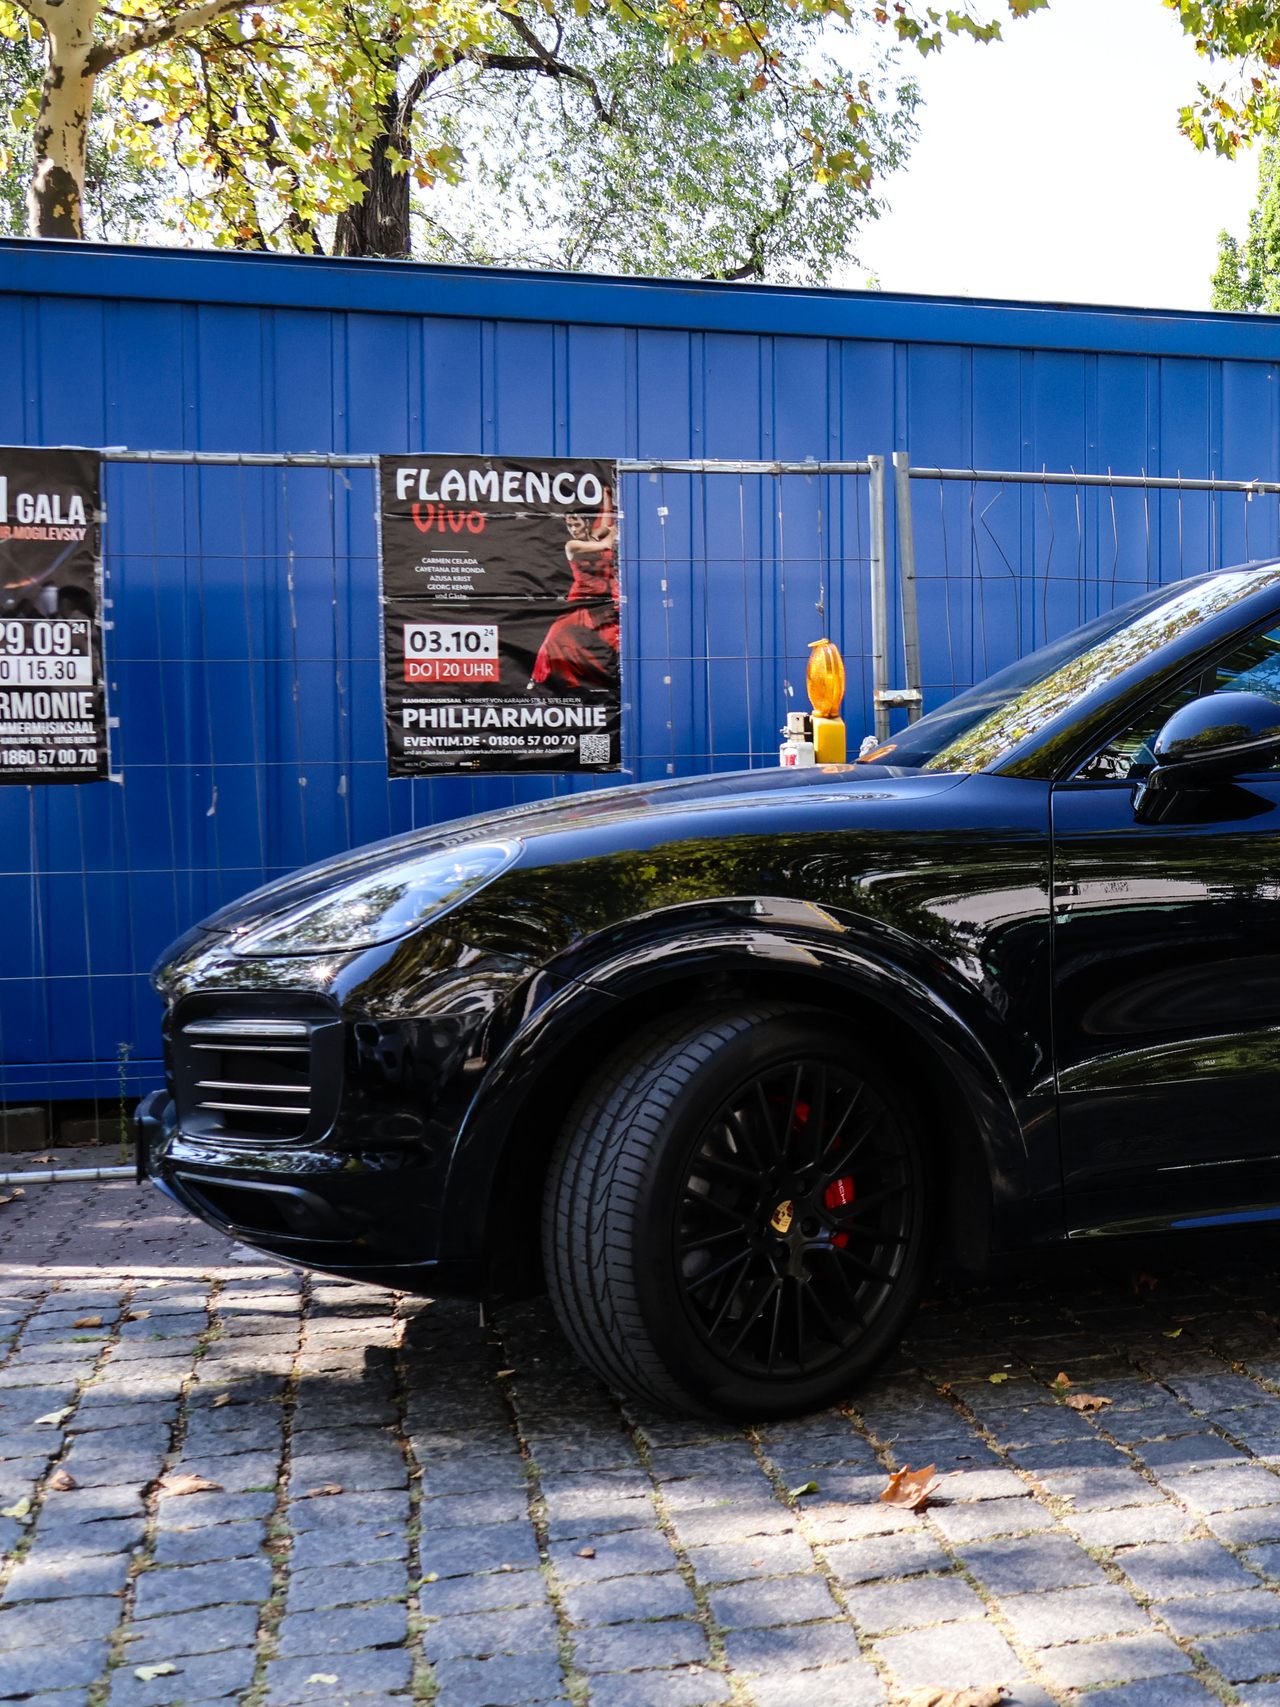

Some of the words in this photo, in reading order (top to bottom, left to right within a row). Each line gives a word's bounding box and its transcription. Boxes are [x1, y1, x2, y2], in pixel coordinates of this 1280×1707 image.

[396, 468, 603, 505] FLAMENCO
[16, 493, 87, 525] GALA
[13, 526, 87, 541] MOGILEVSKY
[426, 583, 451, 591] GEORG
[71, 623, 86, 634] 24
[409, 630, 490, 653] 03.10.
[483, 628, 495, 638] 24
[27, 661, 77, 680] 15.30
[409, 663, 433, 677] DO
[442, 663, 460, 677] 20
[463, 663, 495, 677] UHR
[402, 707, 608, 729] PHILHARMONIE
[403, 736, 480, 747] EVENTIM.DE
[488, 735, 525, 746] 01806
[527, 735, 541, 746] 57
[542, 735, 560, 746] 00
[561, 735, 577, 746] 70
[0, 749, 36, 765] 1860
[38, 749, 56, 764] 57
[57, 749, 77, 764] 00
[78, 748, 98, 764] 70
